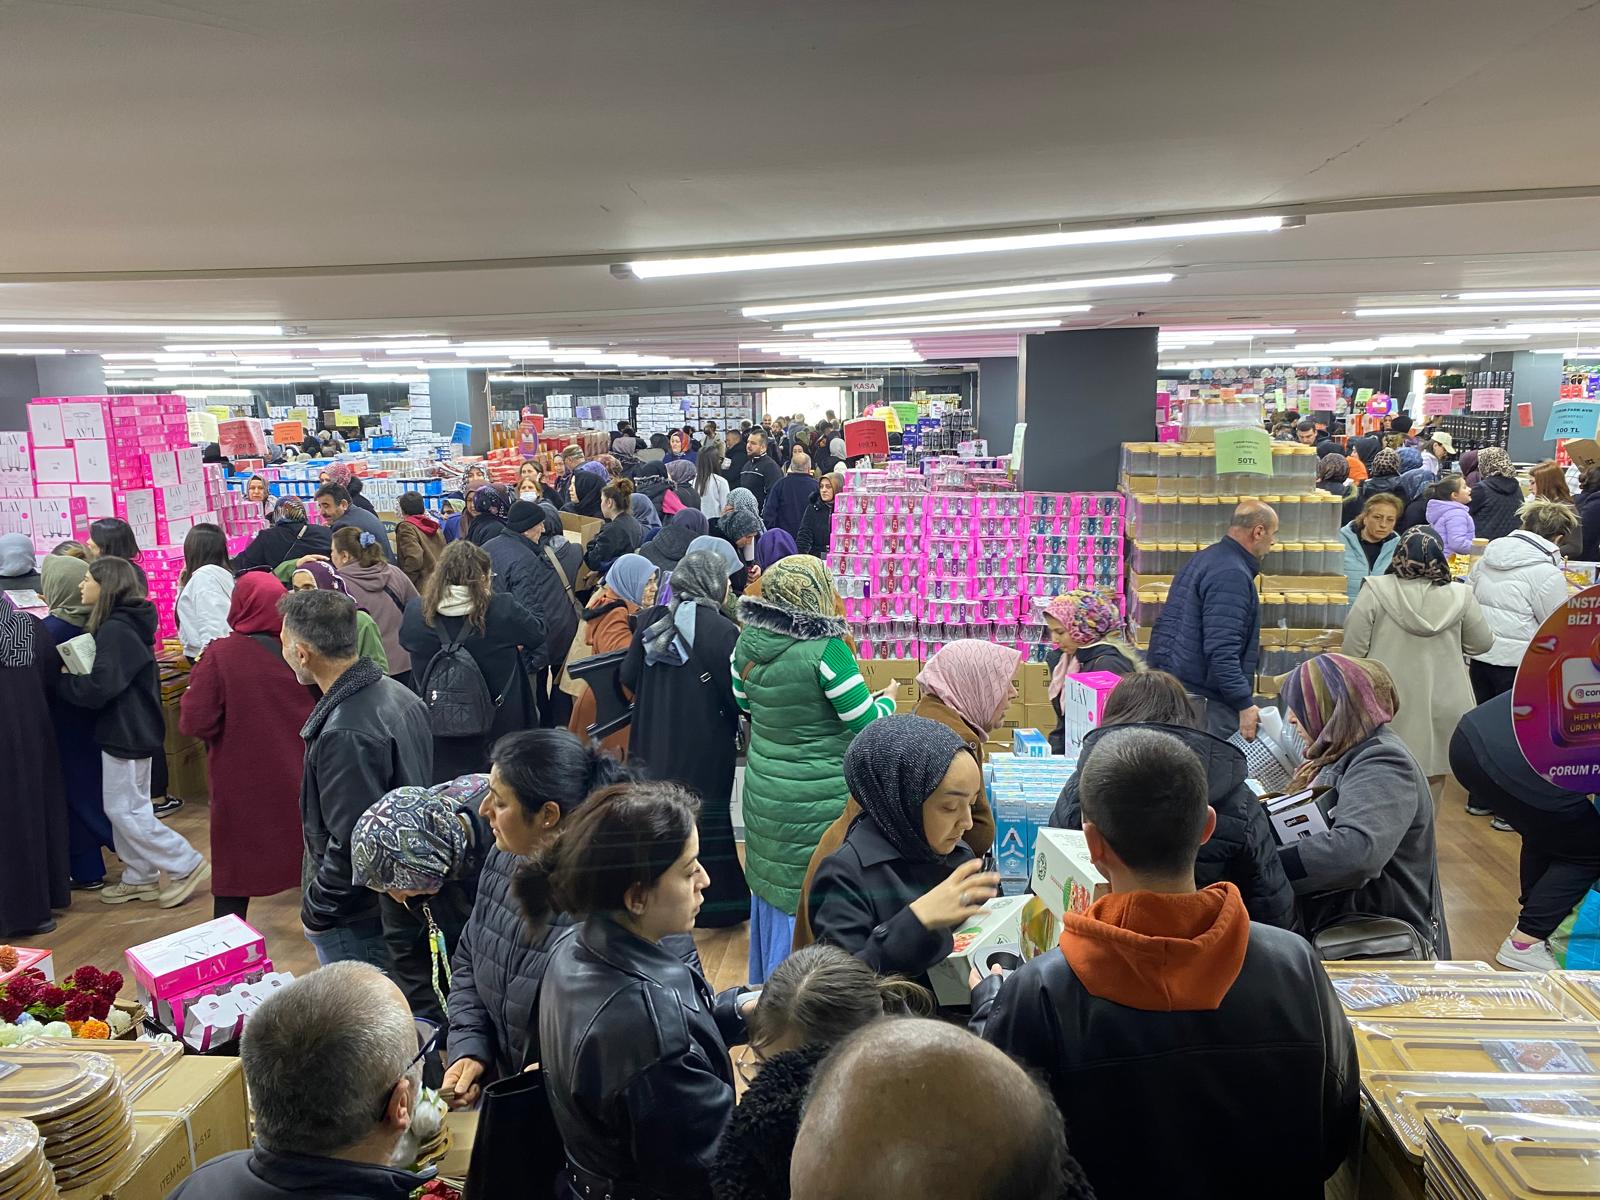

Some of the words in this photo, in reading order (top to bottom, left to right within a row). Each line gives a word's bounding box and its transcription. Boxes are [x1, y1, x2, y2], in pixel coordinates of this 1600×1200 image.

[1237, 457, 1257, 465] 50TL
[0, 501, 20, 512] LAV
[39, 500, 60, 512] LAV
[1568, 612, 1592, 625] BİZİ
[1070, 682, 1089, 708] LAV
[1574, 712, 1590, 721] HER
[196, 956, 228, 980] LAV
[159, 1168, 176, 1193] ITEM
[176, 1156, 187, 1173] NO
